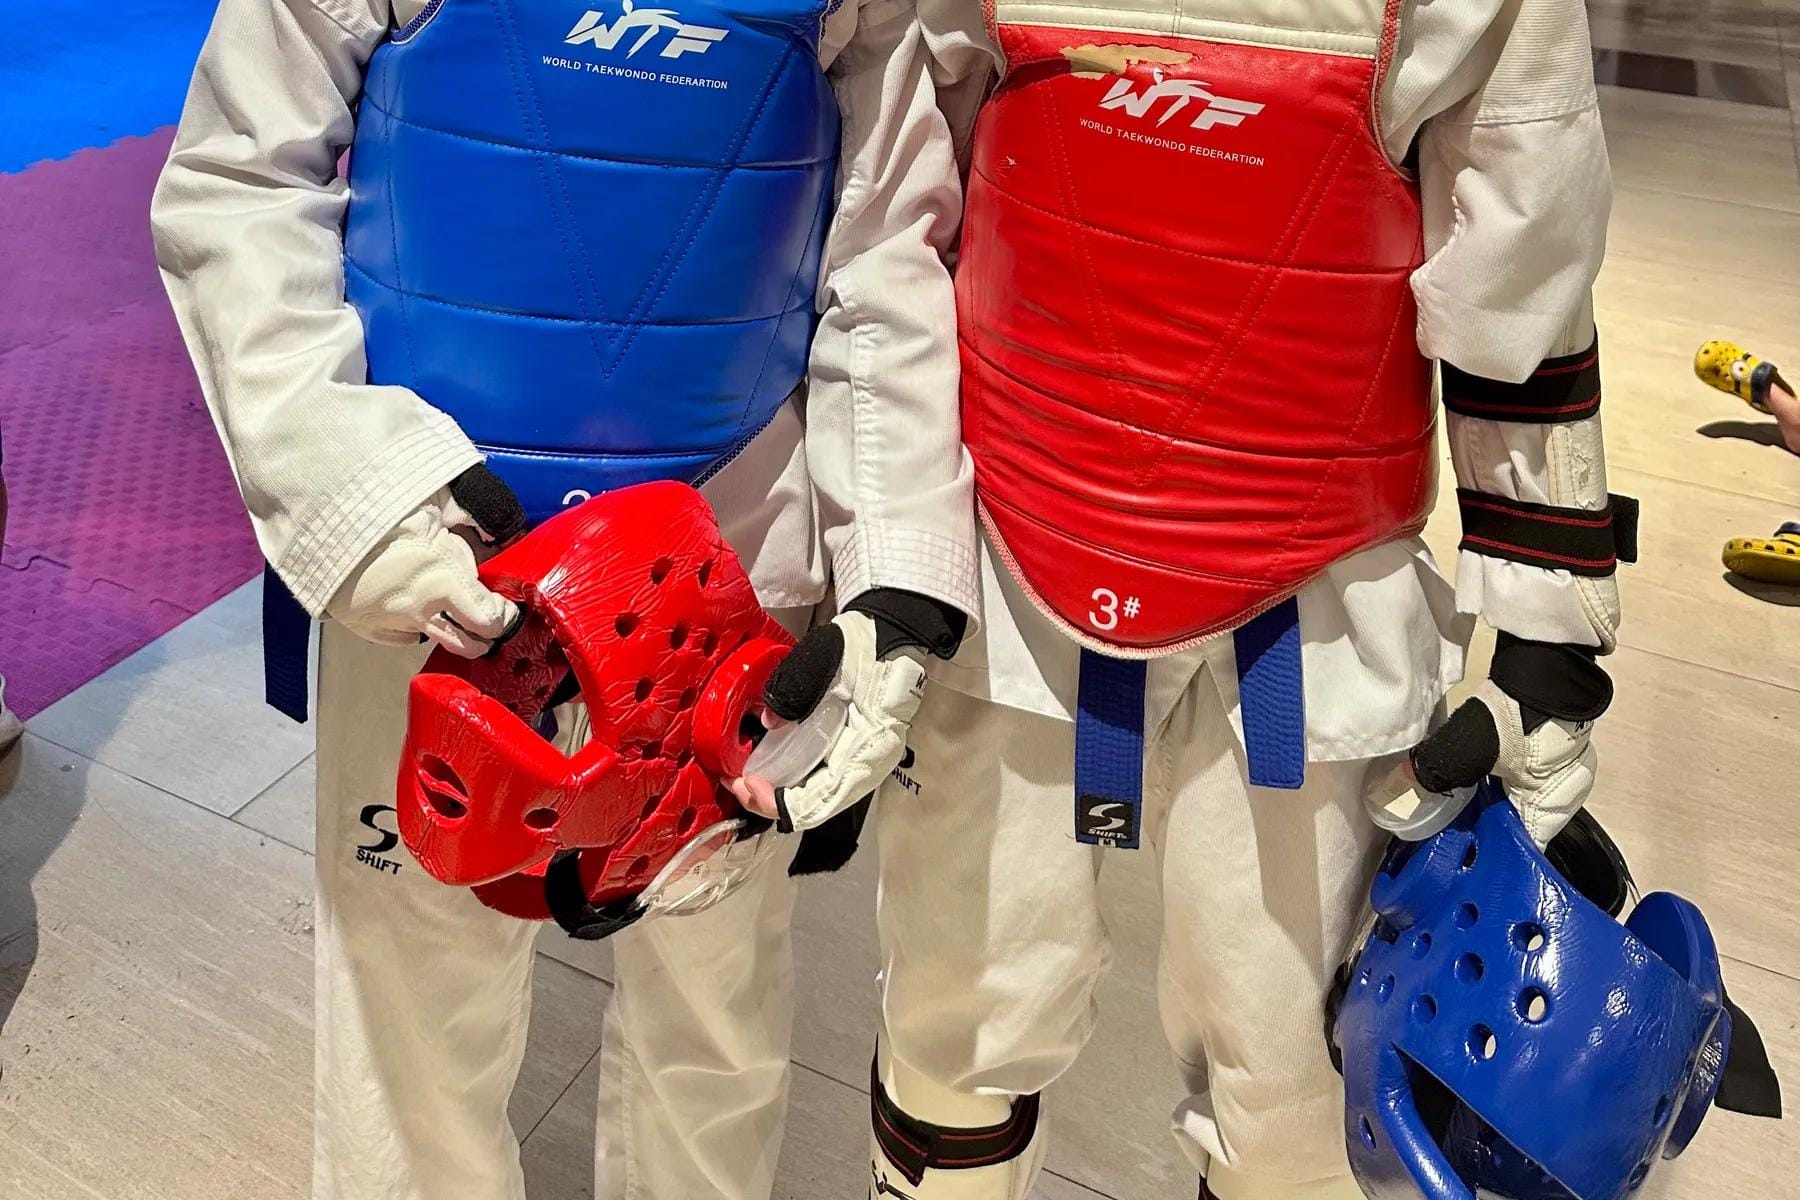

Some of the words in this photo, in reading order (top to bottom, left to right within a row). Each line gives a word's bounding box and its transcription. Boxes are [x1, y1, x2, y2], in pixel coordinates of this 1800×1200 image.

[542, 55, 582, 70] WORLD
[585, 63, 657, 82] TAEKWONDO
[1098, 66, 1266, 131] WTF
[1080, 117, 1113, 135] WORLD
[1117, 128, 1187, 152] TAEKWONDO
[1087, 828, 1125, 839] SHIFT
[355, 848, 403, 875] SHIFT
